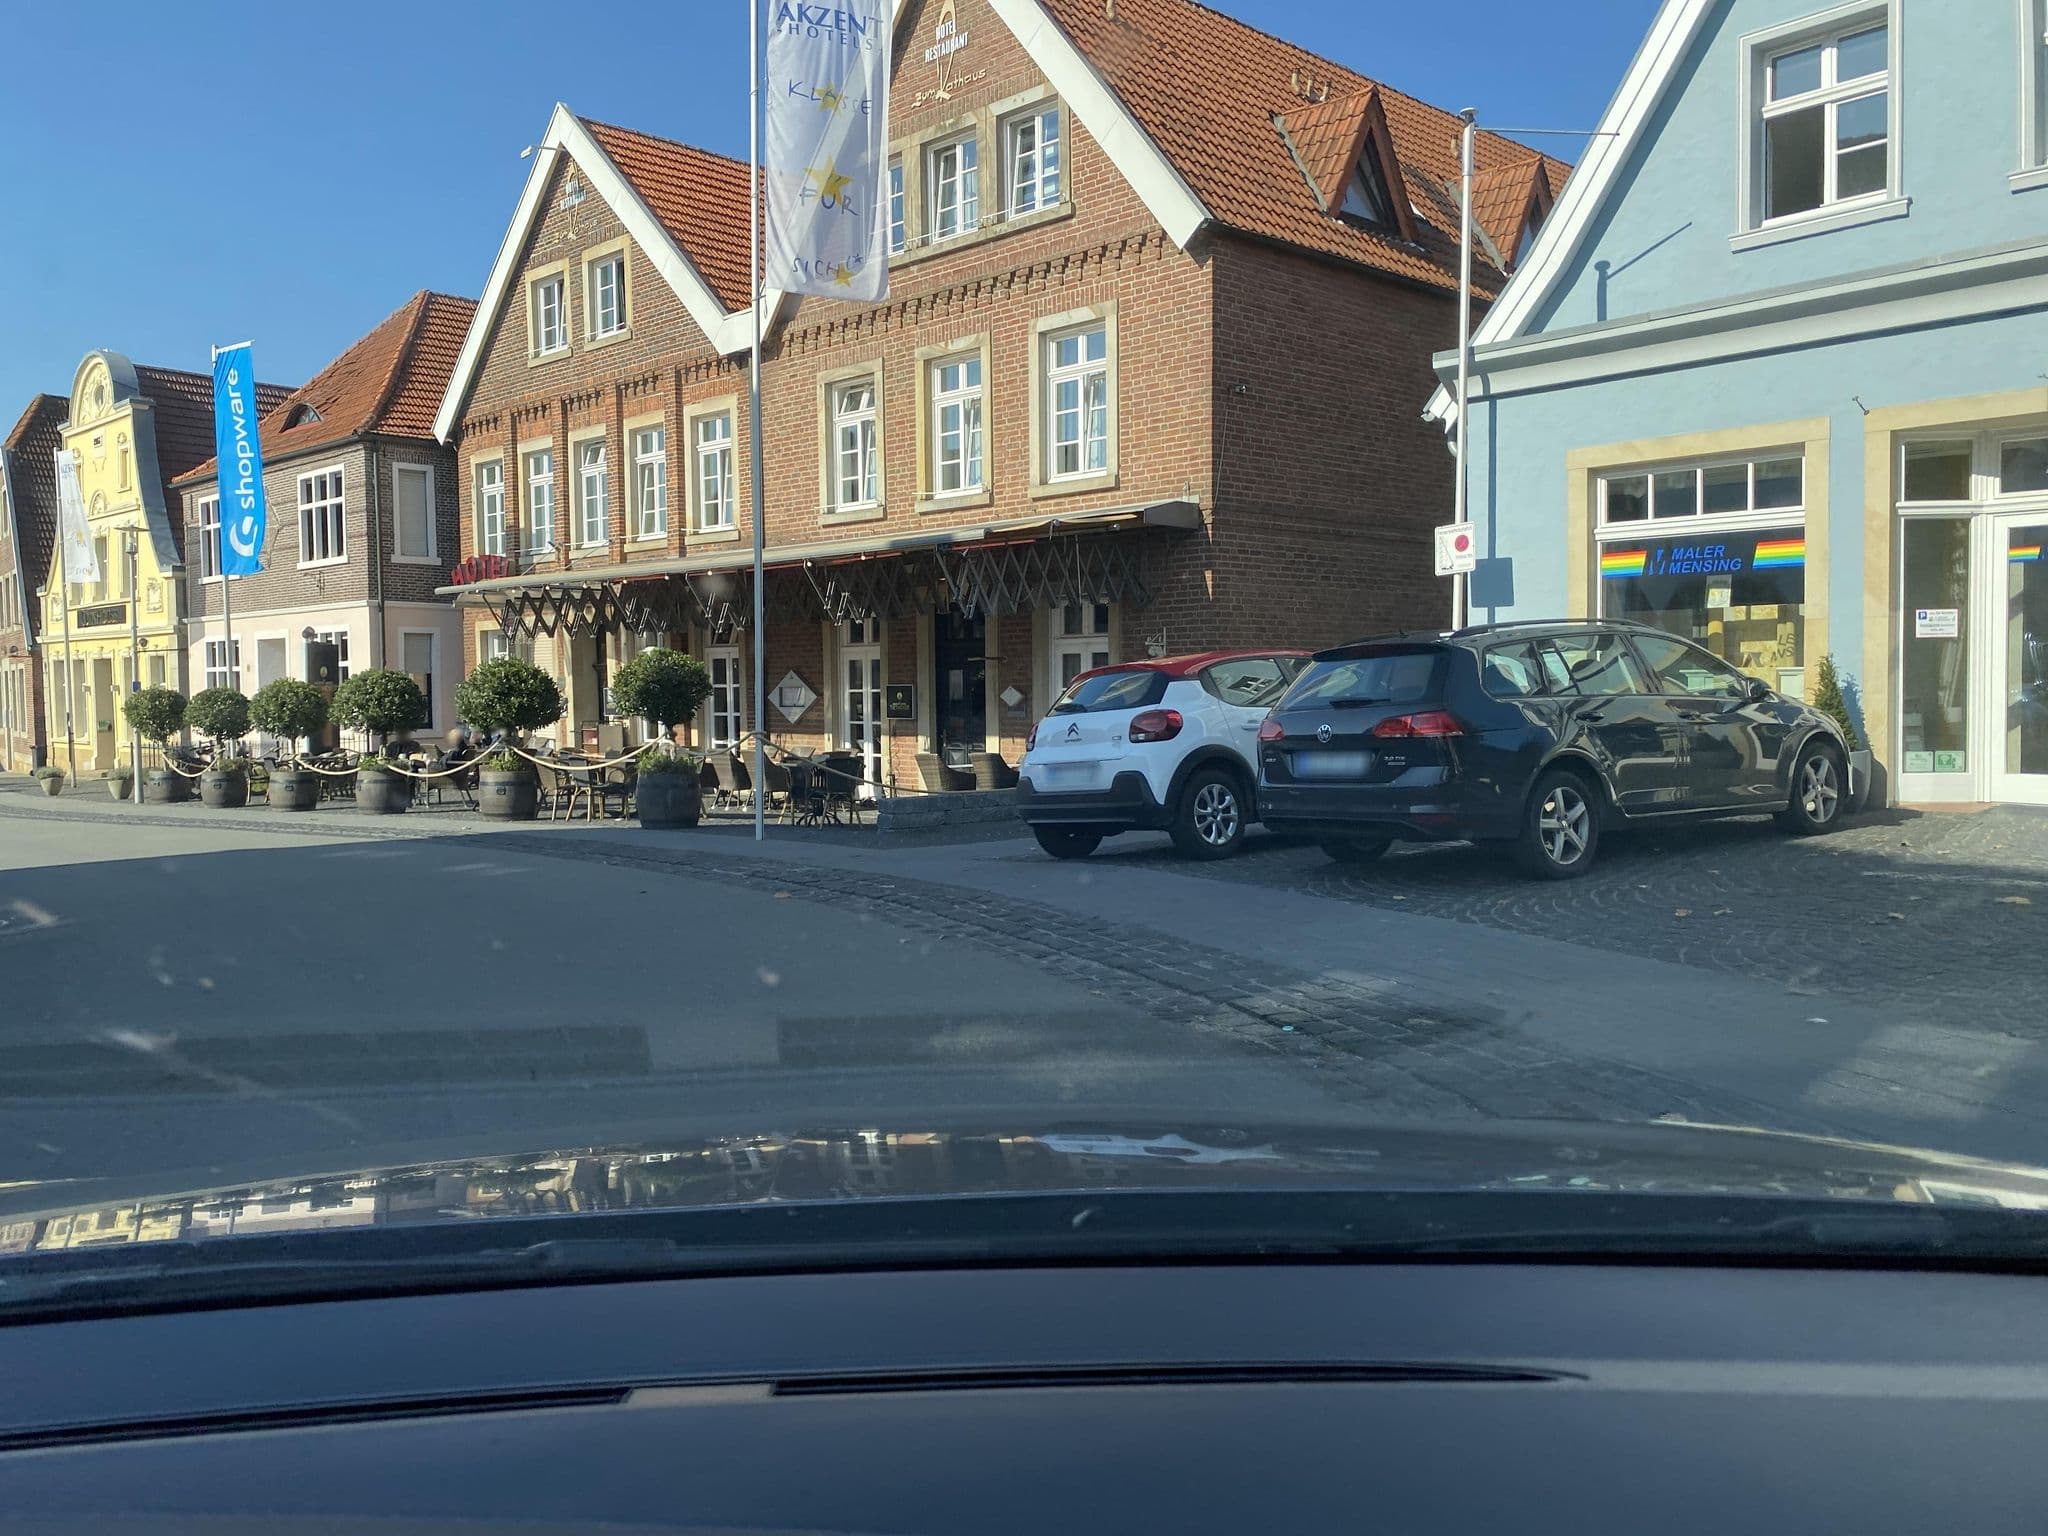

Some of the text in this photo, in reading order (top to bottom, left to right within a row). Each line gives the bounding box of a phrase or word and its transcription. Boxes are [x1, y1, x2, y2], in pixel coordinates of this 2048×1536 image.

[777, 2, 883, 39] AKZENT
[935, 20, 957, 41] HOTEL
[925, 32, 969, 63] RESTAURANT
[227, 367, 255, 509] shopware
[1671, 545, 1726, 560] MALER
[1669, 558, 1742, 574] MENSING
